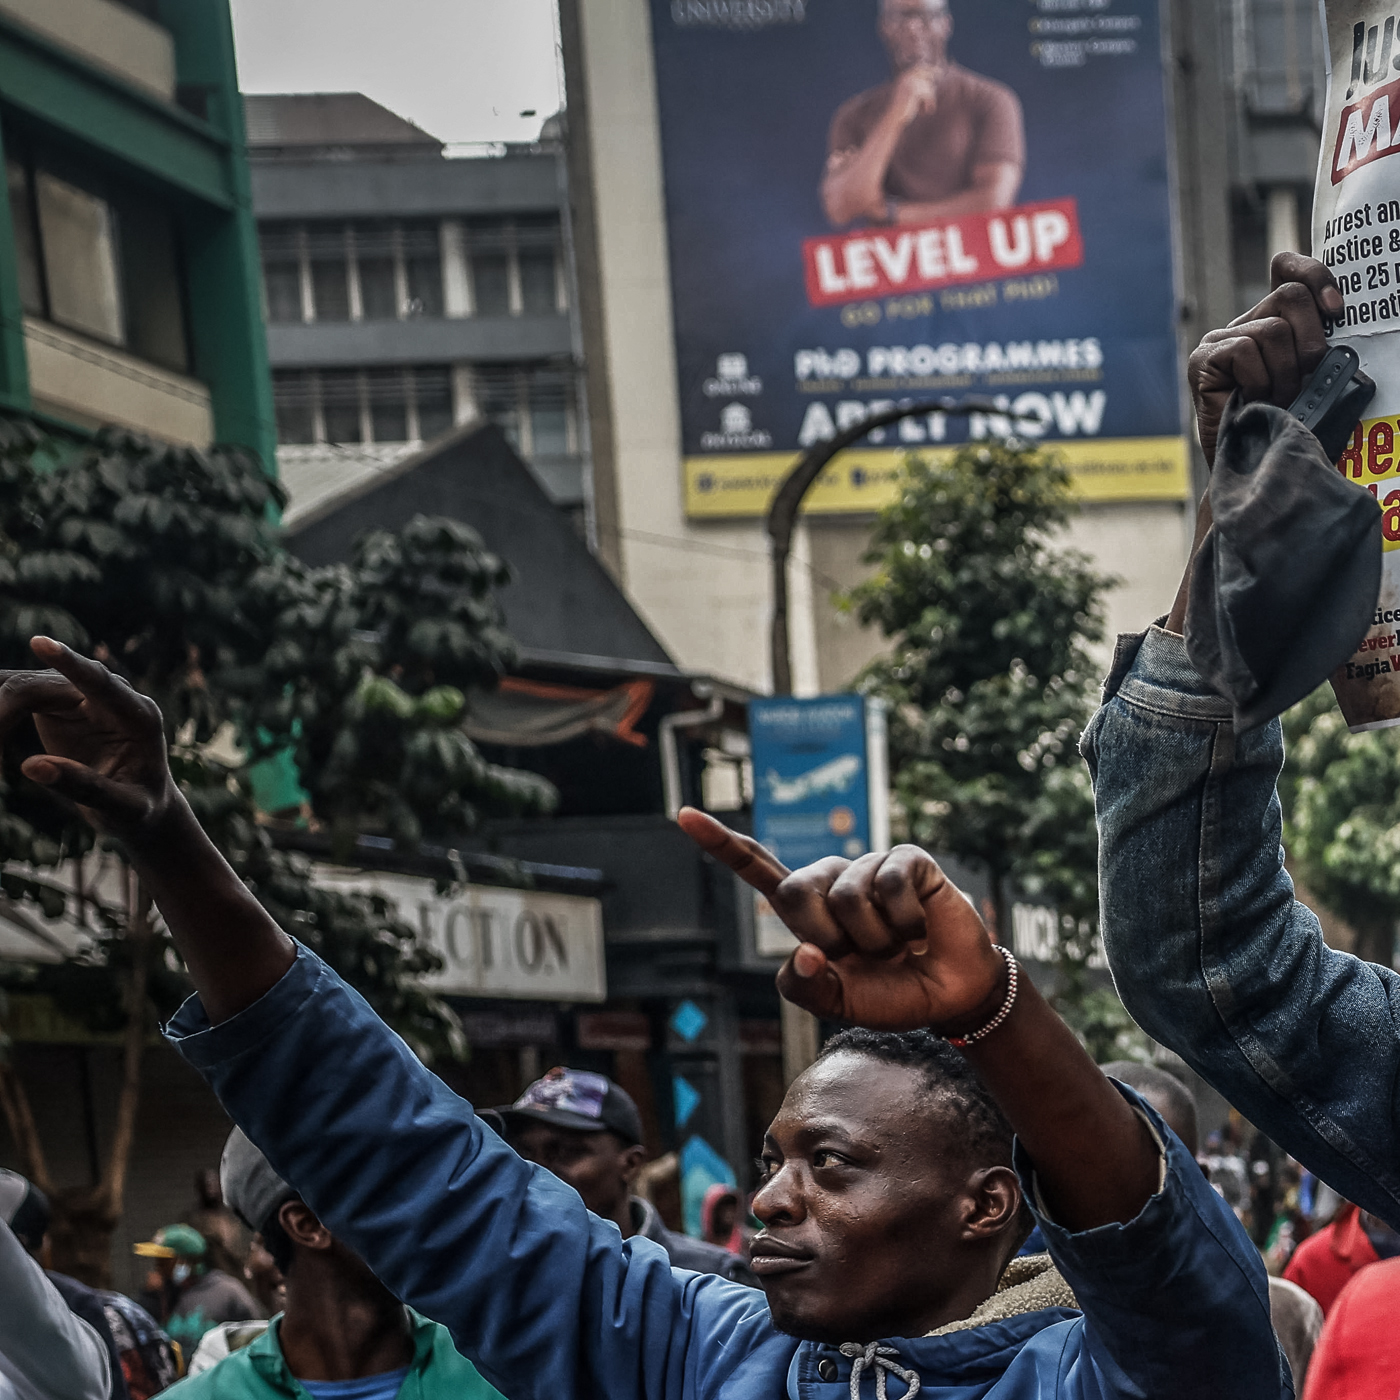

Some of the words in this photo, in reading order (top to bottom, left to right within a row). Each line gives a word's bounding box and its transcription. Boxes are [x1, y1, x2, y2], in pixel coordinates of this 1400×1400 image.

[1324, 203, 1372, 243] Arrest
[815, 225, 978, 293] LEVEL
[988, 210, 1070, 267] UP
[1366, 262, 1390, 290] 25
[794, 347, 861, 380] PhD
[867, 337, 1103, 378] PROGRAMMES
[969, 390, 1106, 438] NOW
